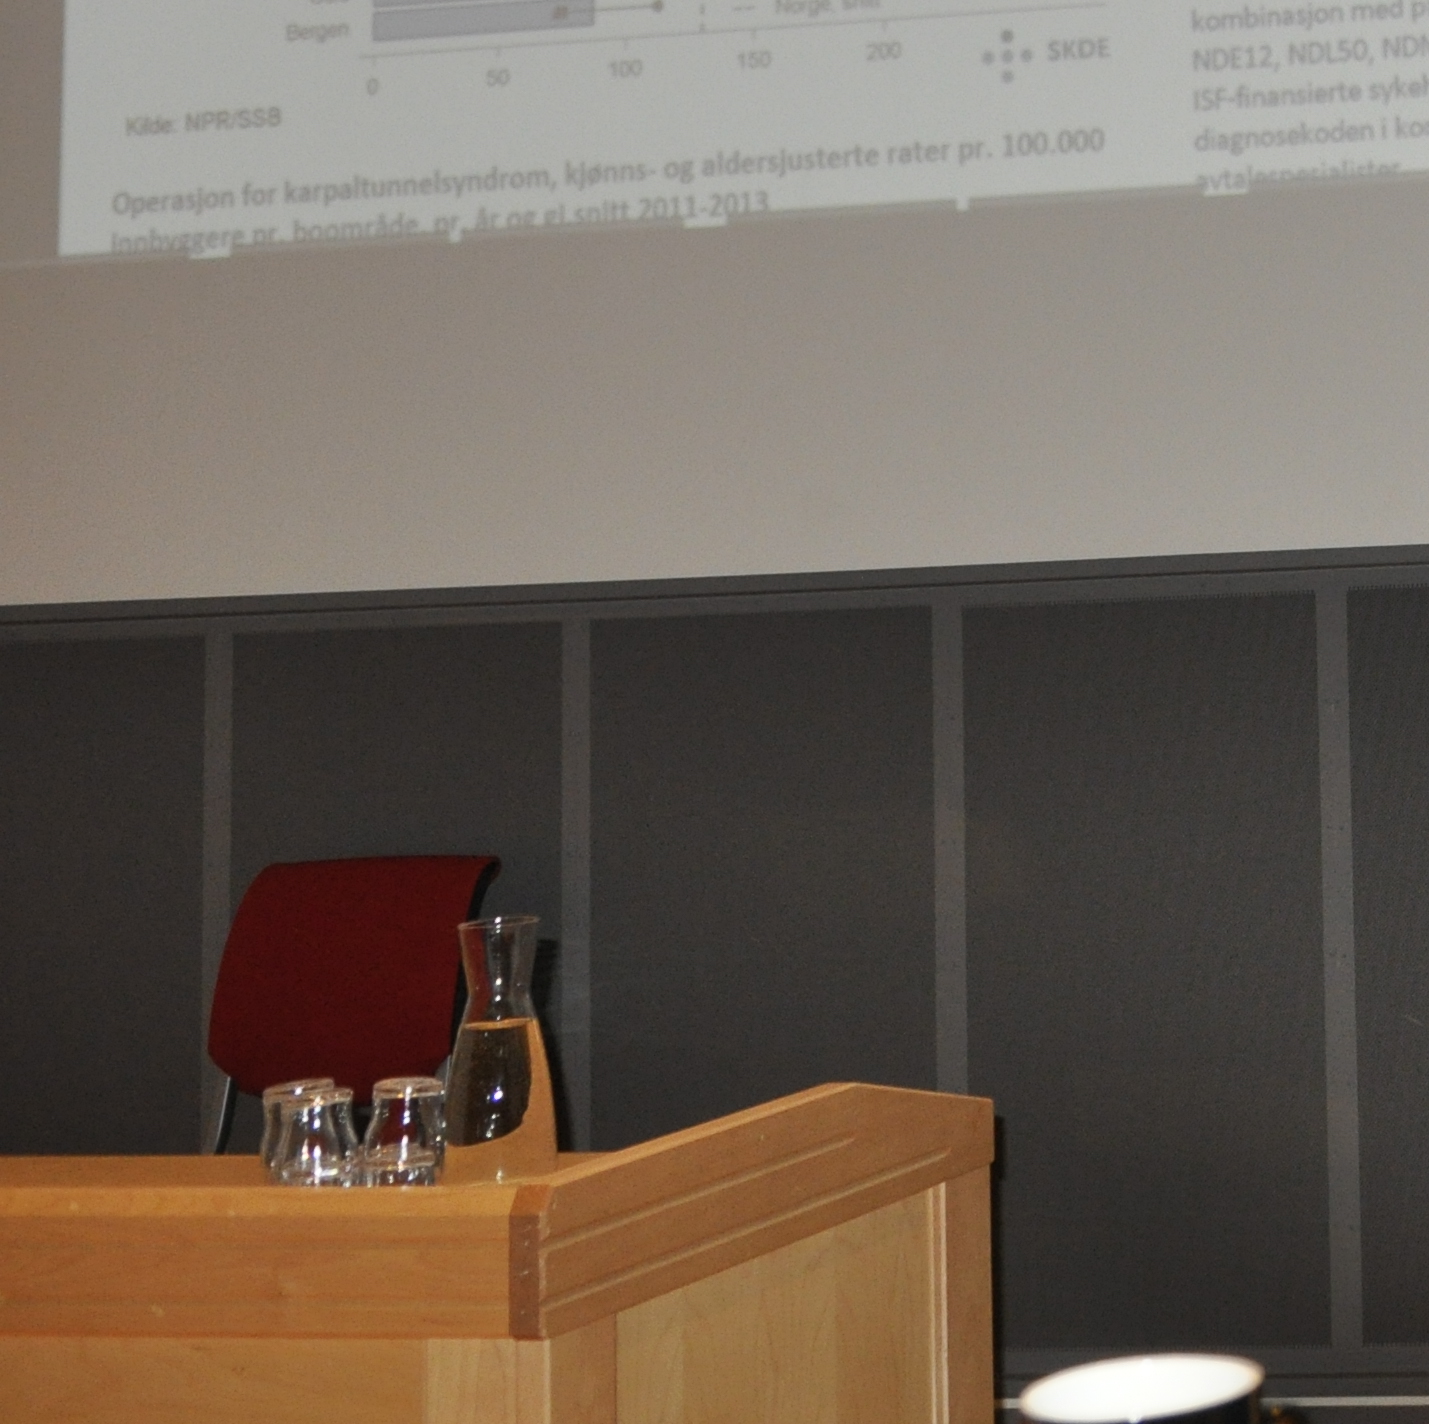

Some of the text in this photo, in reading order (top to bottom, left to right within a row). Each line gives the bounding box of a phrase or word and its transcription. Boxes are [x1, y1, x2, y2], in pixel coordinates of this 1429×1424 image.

[1189, 2, 1345, 33] kombinasjon
[284, 21, 351, 45] Bergen
[735, 48, 774, 71] 150
[865, 39, 904, 63] 200
[1046, 35, 1111, 63] SKDE
[1190, 43, 1280, 73] NDE12,
[485, 67, 512, 89] 50
[606, 58, 645, 80] 100
[365, 76, 381, 98] 0
[1192, 80, 1364, 113] ISF-finansierte
[1192, 118, 1376, 158] diagnosekoden
[110, 185, 237, 220] Operasjon
[240, 180, 278, 208] for
[282, 164, 558, 208] karpaltunnelsyndrom,
[661, 158, 696, 185] og
[700, 143, 881, 179] aldersjusterte
[885, 140, 951, 166] rater
[957, 140, 993, 167] pr.
[1002, 126, 1107, 160] 100.000
